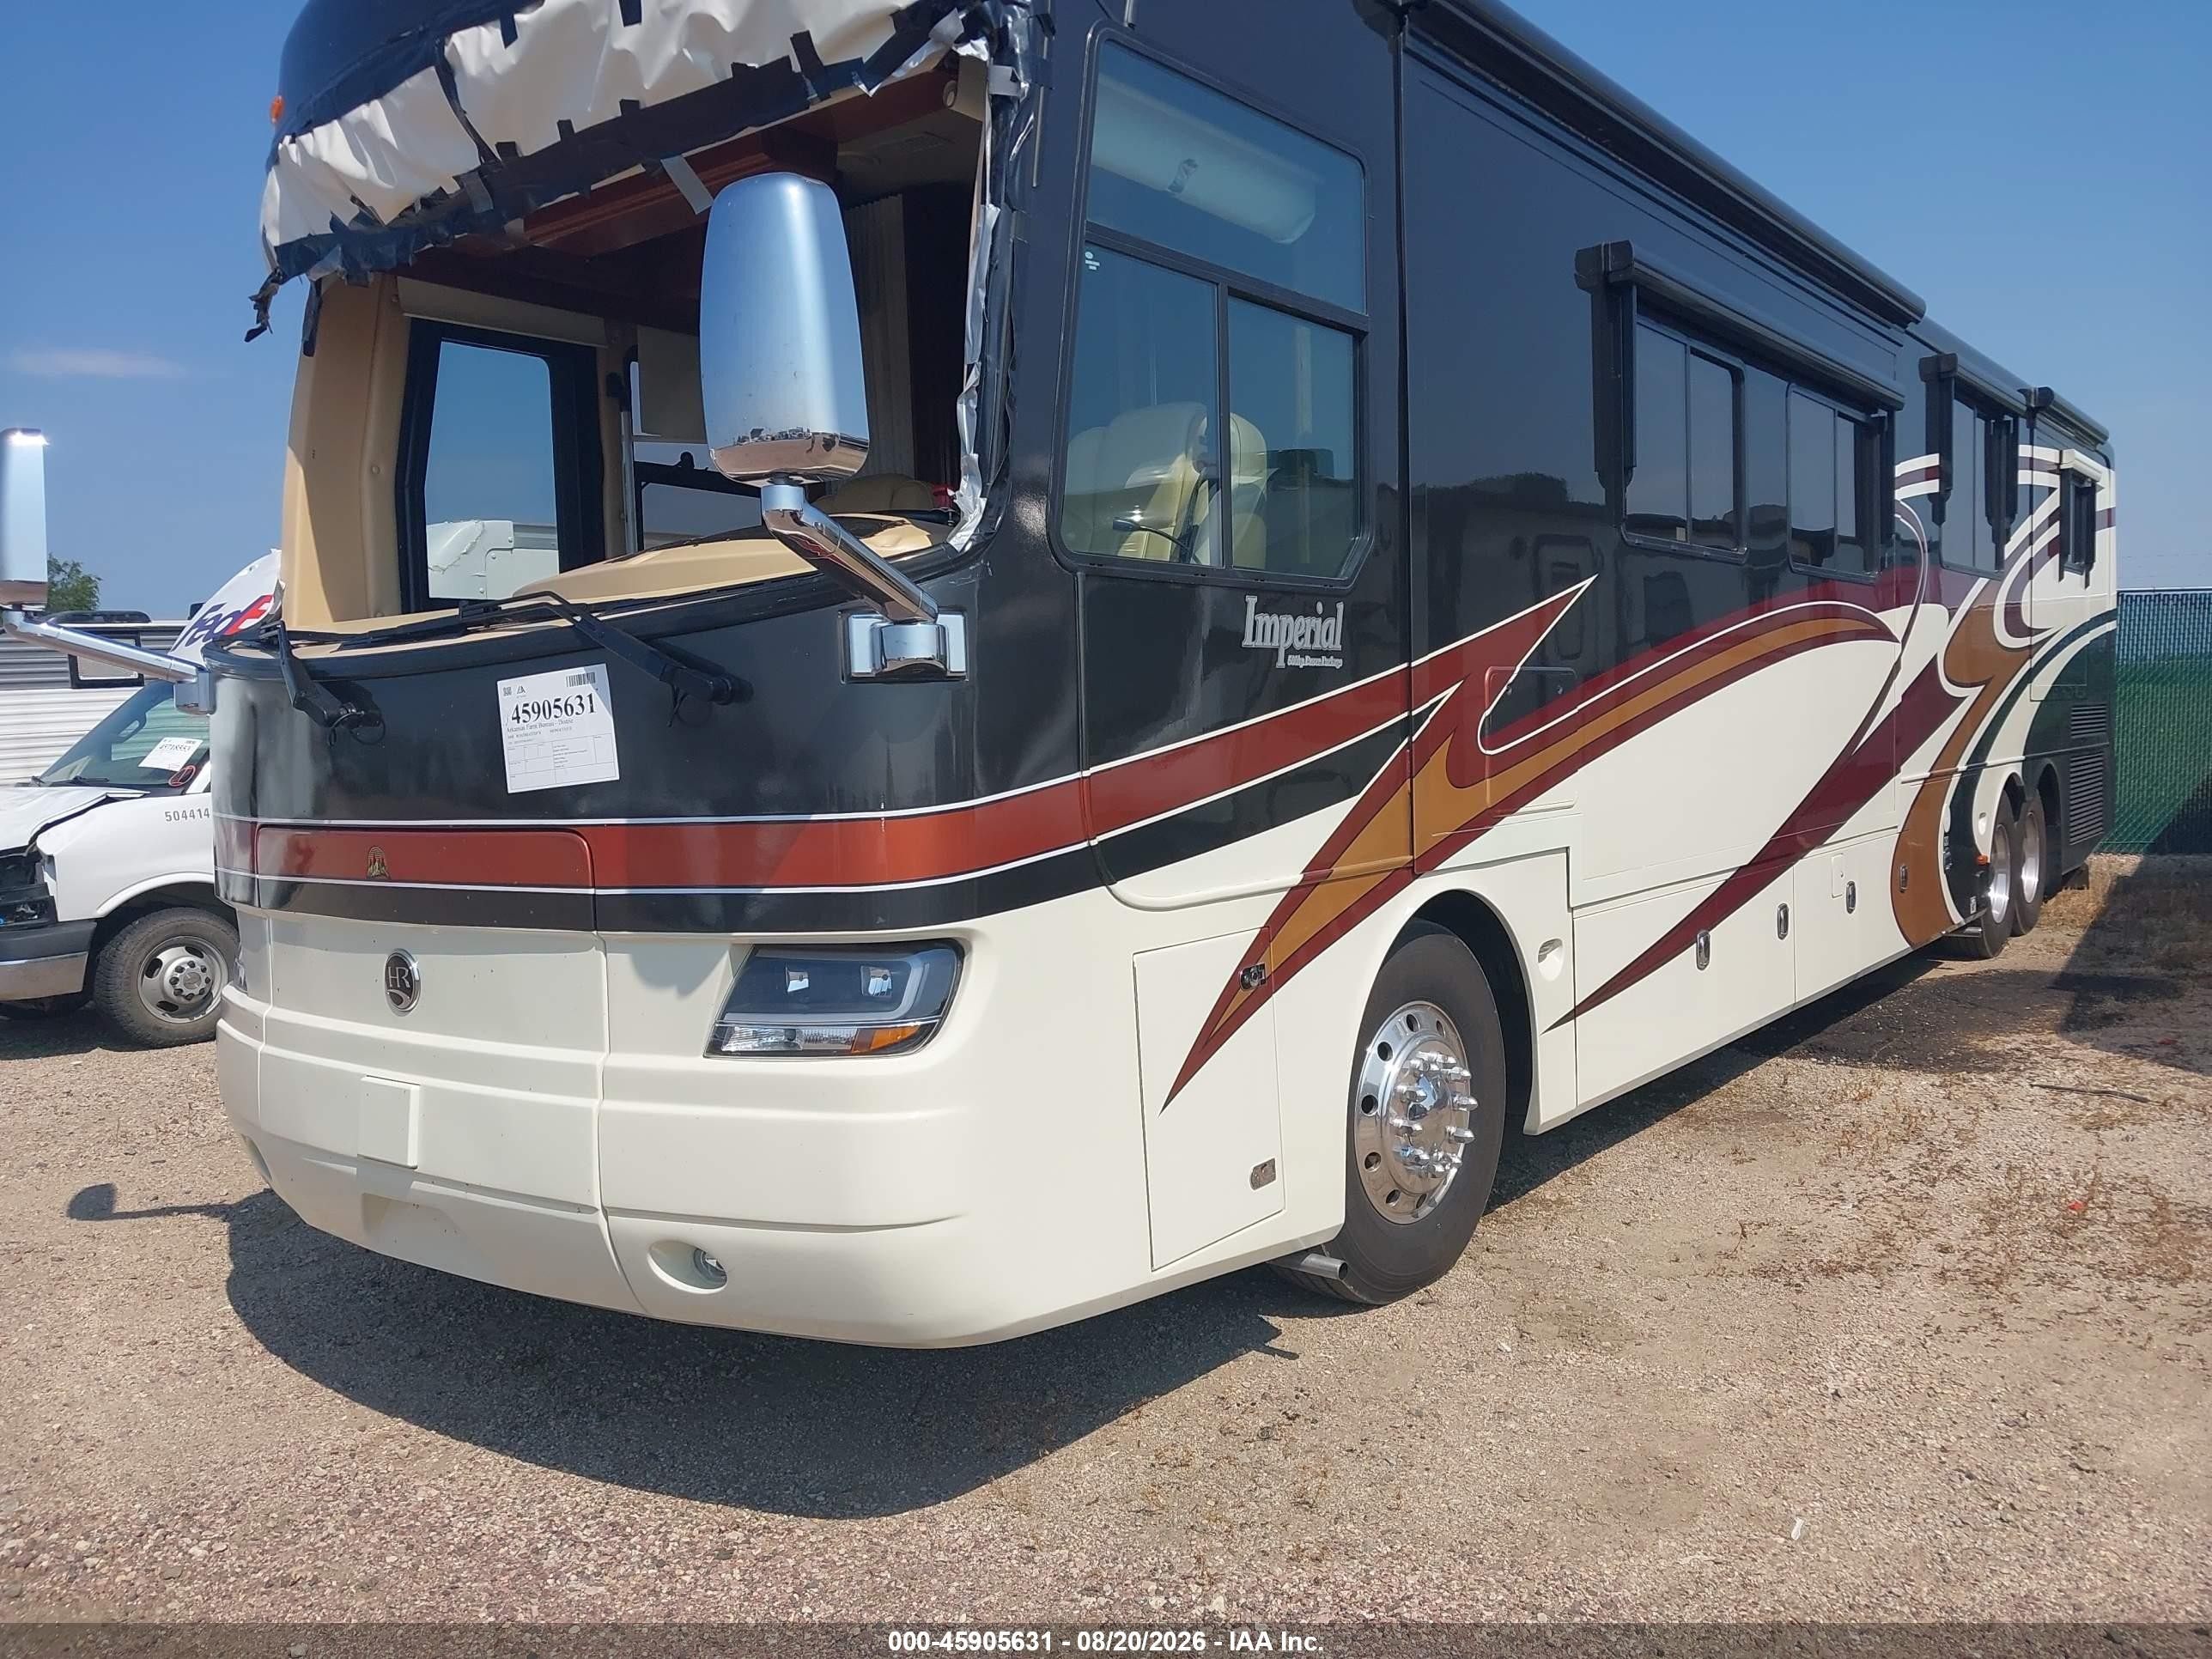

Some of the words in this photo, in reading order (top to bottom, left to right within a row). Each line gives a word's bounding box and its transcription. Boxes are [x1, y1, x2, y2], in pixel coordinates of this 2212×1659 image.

[1242, 595, 1344, 668] Imperial
[511, 693, 596, 724] 45905631
[165, 808, 210, 822] 504414
[388, 966, 410, 988] HR
